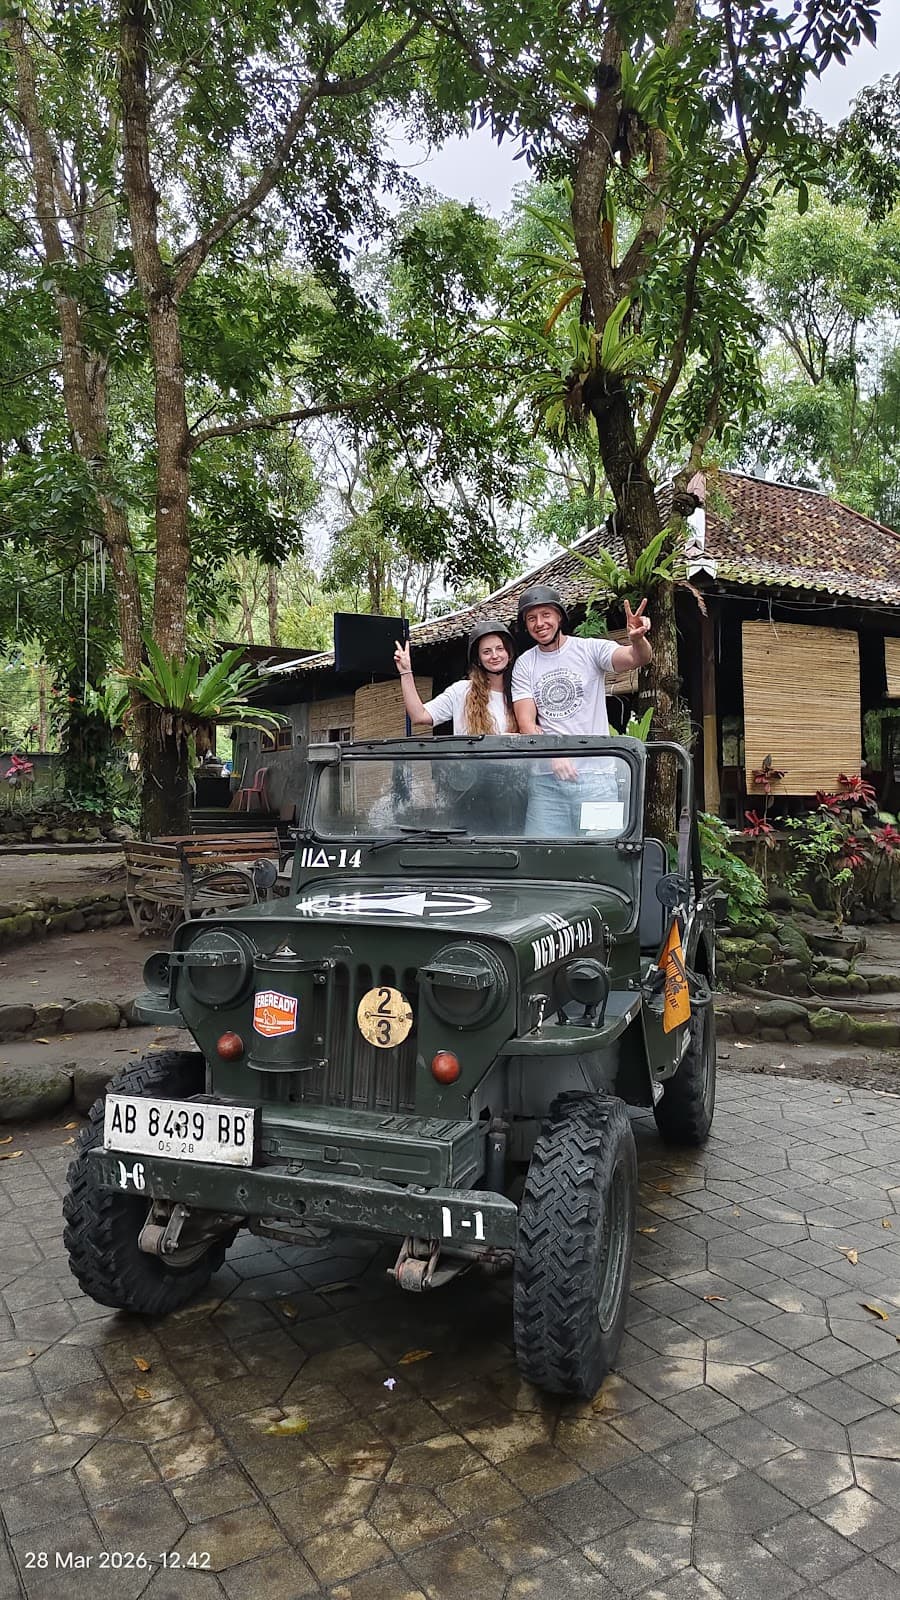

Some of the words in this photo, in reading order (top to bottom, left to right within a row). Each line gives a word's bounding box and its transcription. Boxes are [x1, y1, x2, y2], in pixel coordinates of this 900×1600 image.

[545, 703, 578, 718] NAVIGATOR
[377, 988, 392, 1014] 2
[377, 1019, 391, 1045] 3
[111, 1103, 137, 1134] AB
[148, 1107, 204, 1141] 8439
[218, 1114, 246, 1147] BB
